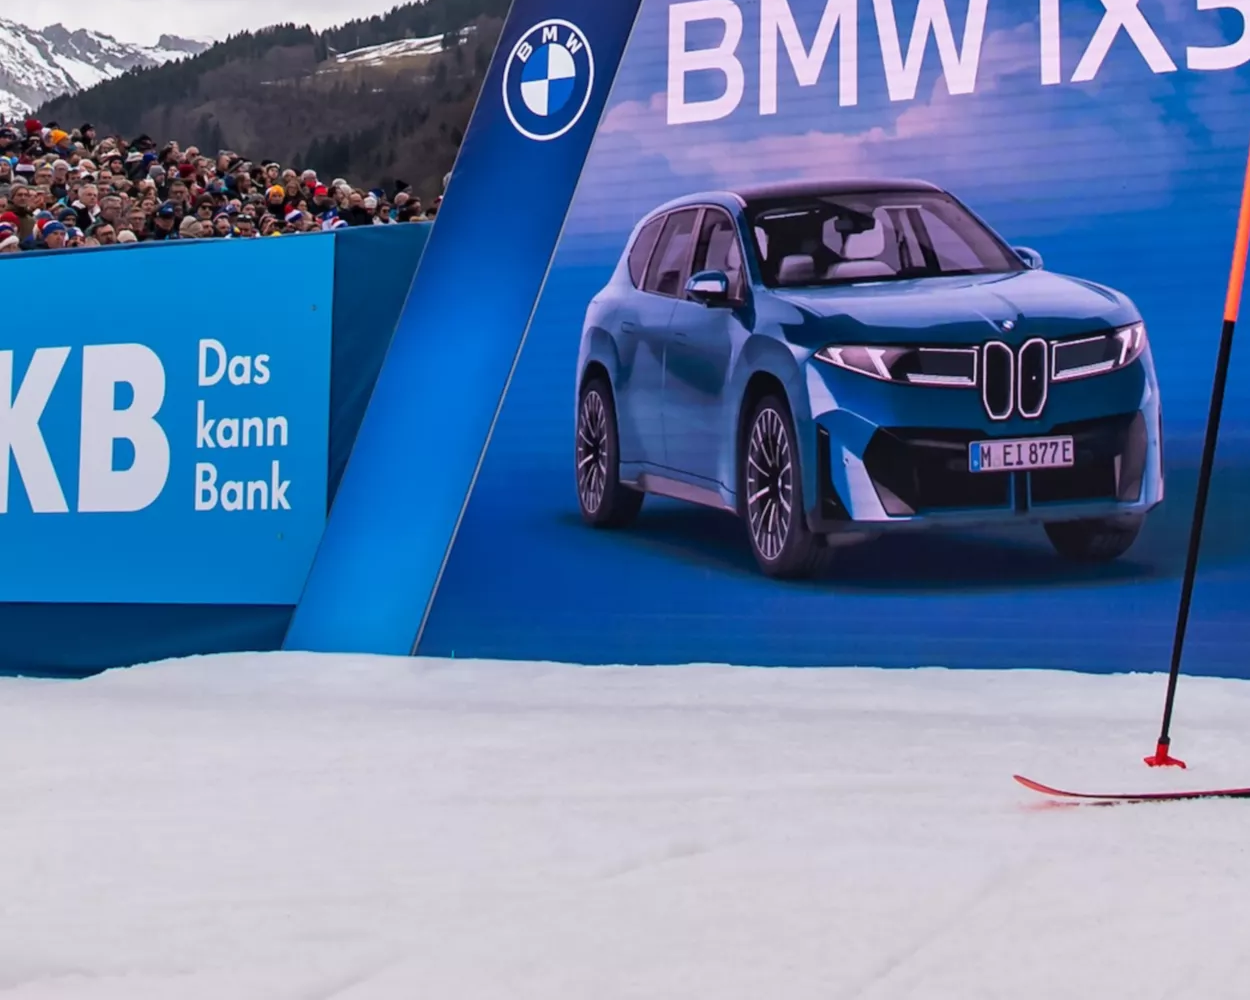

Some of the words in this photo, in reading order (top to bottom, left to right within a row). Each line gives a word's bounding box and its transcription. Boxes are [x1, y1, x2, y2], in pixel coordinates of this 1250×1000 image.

[516, 25, 584, 64] BMW
[198, 338, 271, 387] Das
[196, 400, 289, 449] kann
[981, 445, 991, 468] M
[1003, 444, 1024, 467] EI
[194, 460, 292, 511] Bank
